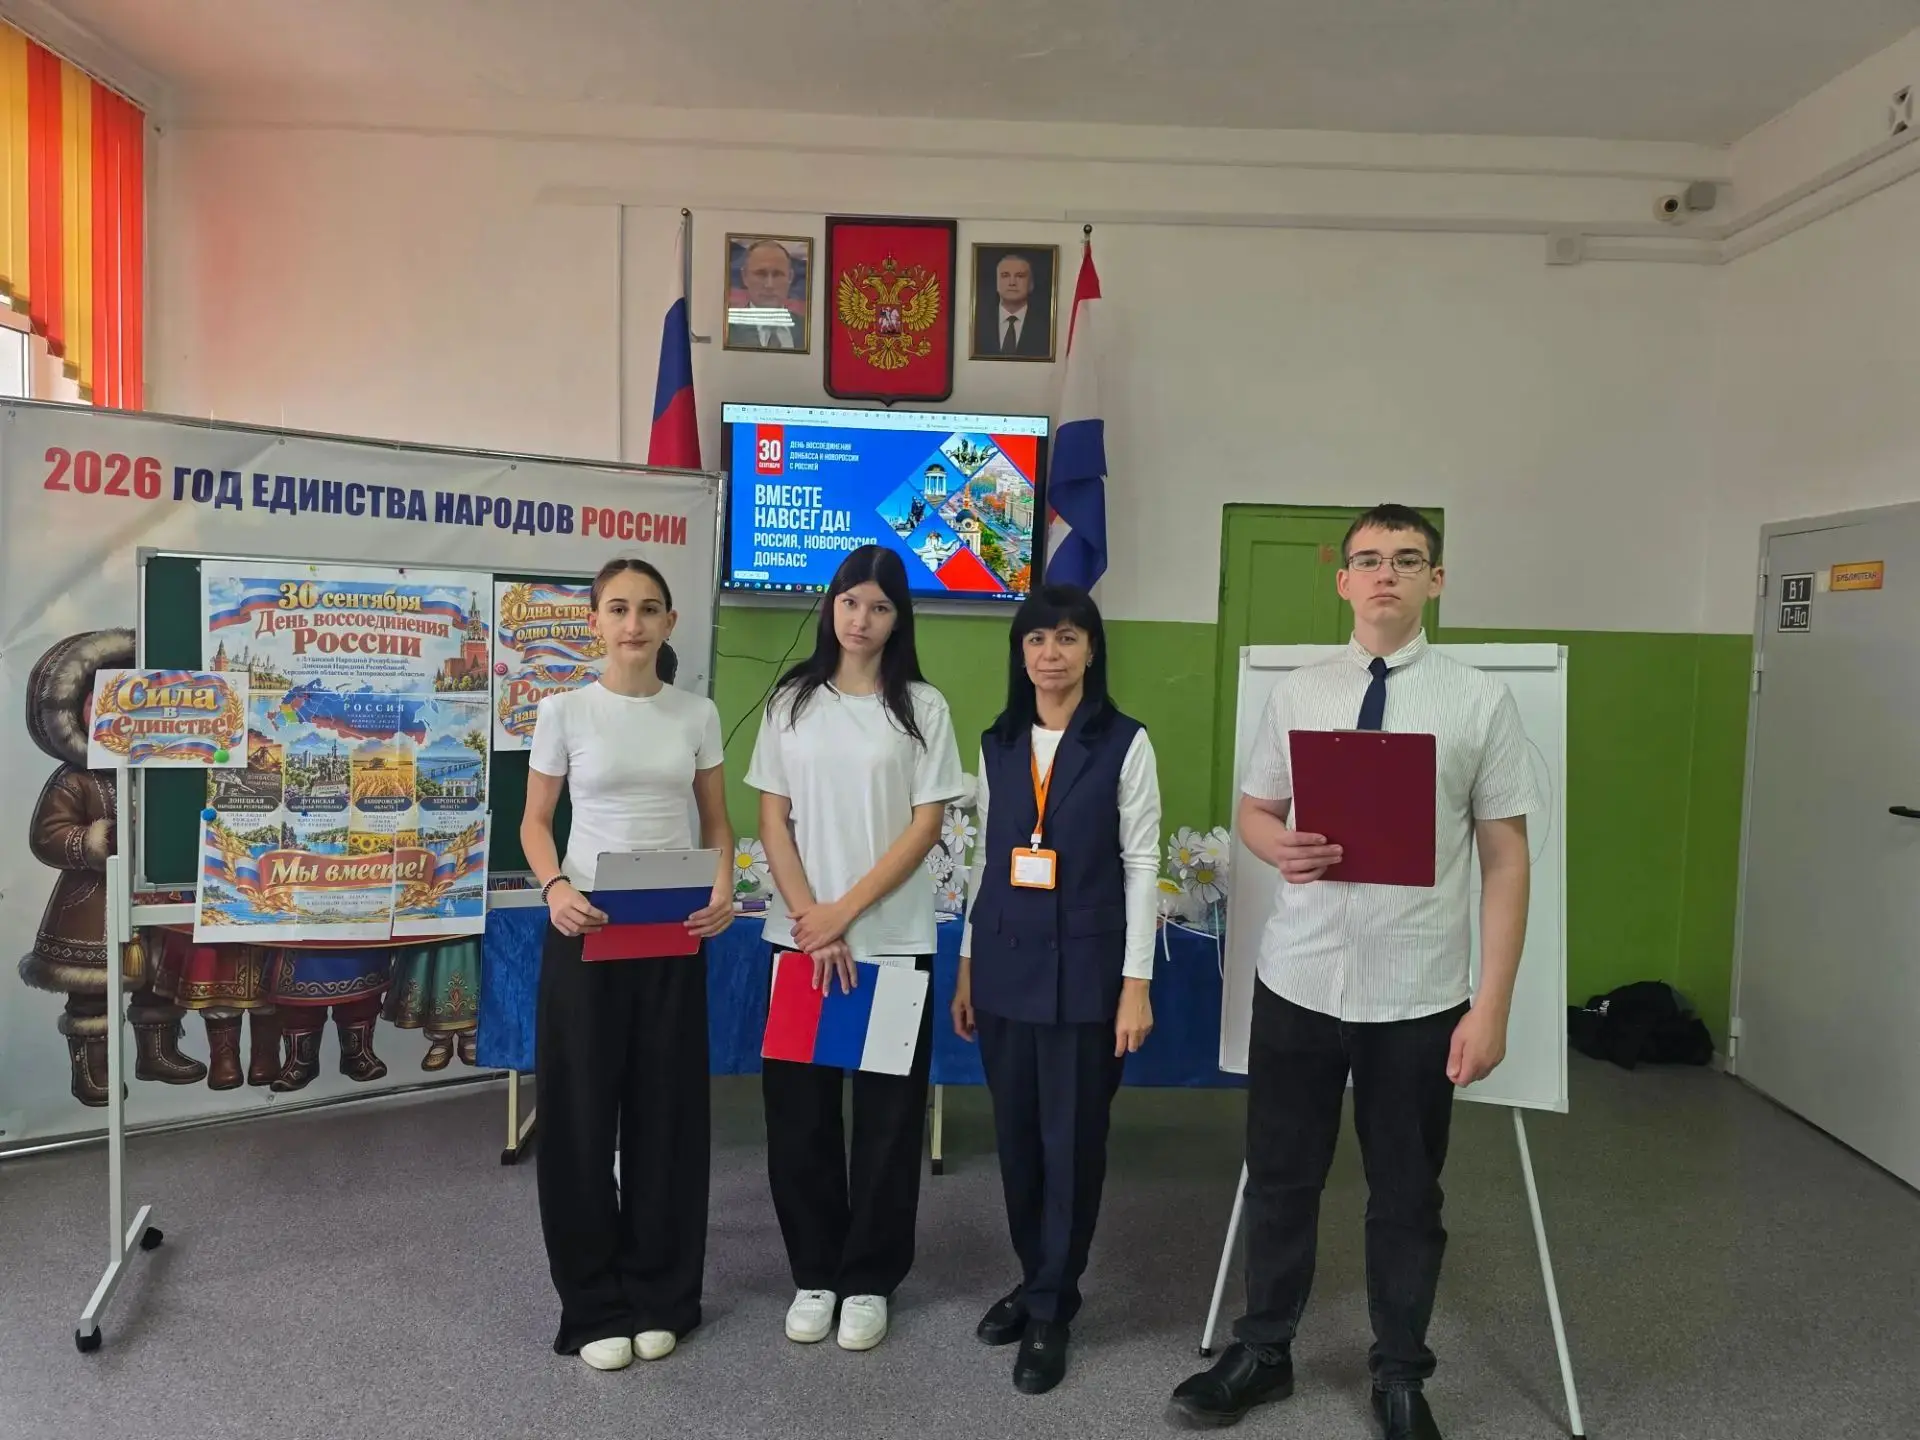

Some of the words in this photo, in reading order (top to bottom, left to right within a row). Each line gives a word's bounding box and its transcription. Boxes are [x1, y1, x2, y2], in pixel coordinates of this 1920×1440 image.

[759, 439, 781, 461] 30
[790, 441, 804, 449] ДЕНЬ
[790, 452, 818, 460] ДОНБАССА
[824, 454, 860, 462] НОВОРОССИИ
[794, 462, 818, 470] РОССИЕЙ
[44, 447, 162, 500] 2026
[173, 466, 243, 511] ГОД
[252, 473, 427, 522] ЕДИНСТВА
[434, 491, 574, 536] НАРОДОВ
[581, 506, 687, 545] РОССИИ
[755, 484, 823, 508] ВМЕСТЕ
[755, 506, 851, 533] НАВСЕГДА!
[754, 532, 801, 550] РОССИЯ,
[754, 551, 808, 568] ДОНБАСС
[278, 581, 319, 609] 30
[322, 589, 423, 613] сентября
[511, 602, 551, 622] Одна
[255, 609, 309, 639] День
[313, 612, 449, 639] воссоединения
[516, 629, 547, 641] одно
[292, 627, 422, 658] России
[117, 677, 218, 711] Сила
[344, 703, 404, 712] РОССИЯ
[267, 857, 318, 886] Мы
[326, 854, 427, 882] вместе!
